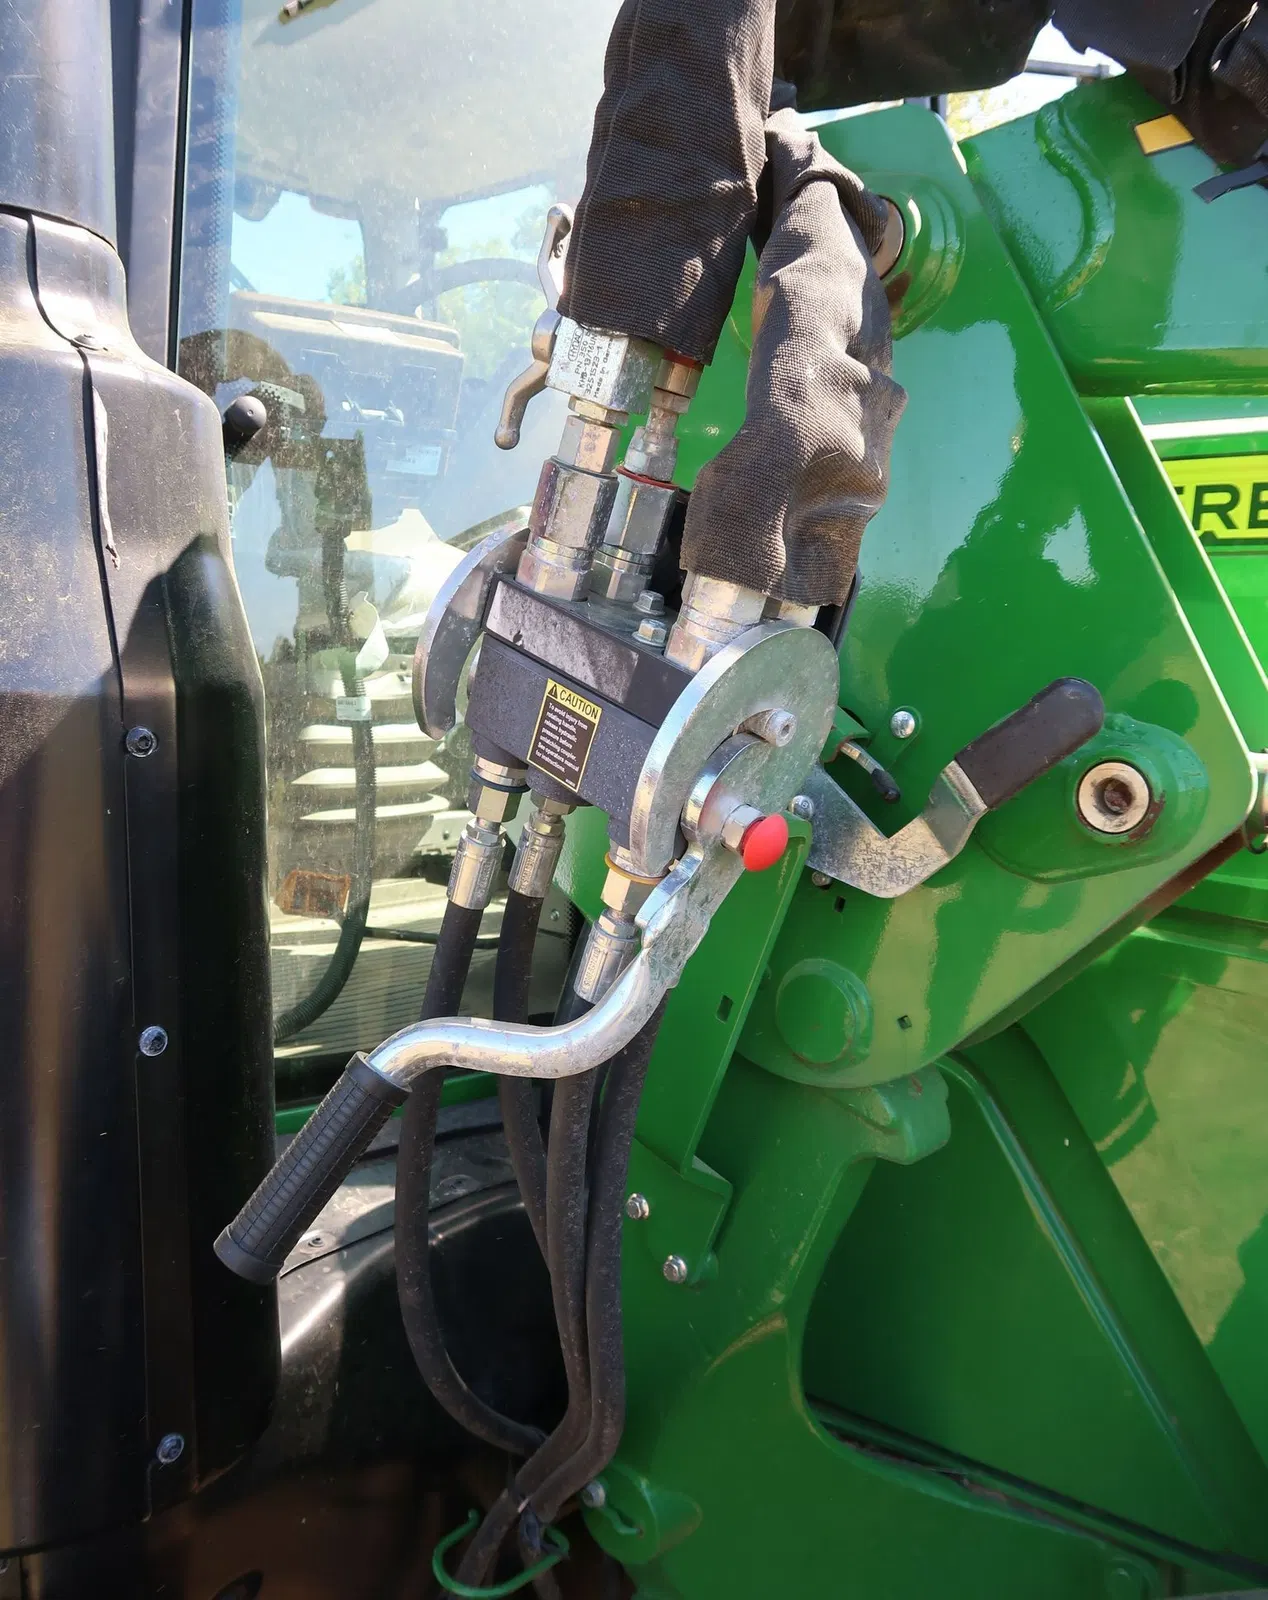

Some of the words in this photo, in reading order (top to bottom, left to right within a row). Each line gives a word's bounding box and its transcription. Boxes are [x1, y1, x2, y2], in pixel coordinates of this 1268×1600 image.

[574, 360, 583, 374] PN
[579, 340, 588, 358] 350
[577, 333, 598, 388] KHB-13/16UN
[602, 336, 614, 363] Germa
[1174, 482, 1268, 531] RE
[545, 710, 562, 725] rotating
[548, 702, 554, 710] To
[553, 705, 565, 717] avoid
[564, 712, 577, 725] injury
[577, 719, 588, 730] from
[558, 689, 598, 719] CAUTION
[541, 726, 559, 741] pressure
[559, 736, 572, 749] before
[537, 741, 545, 750] See
[564, 758, 579, 771] manual
